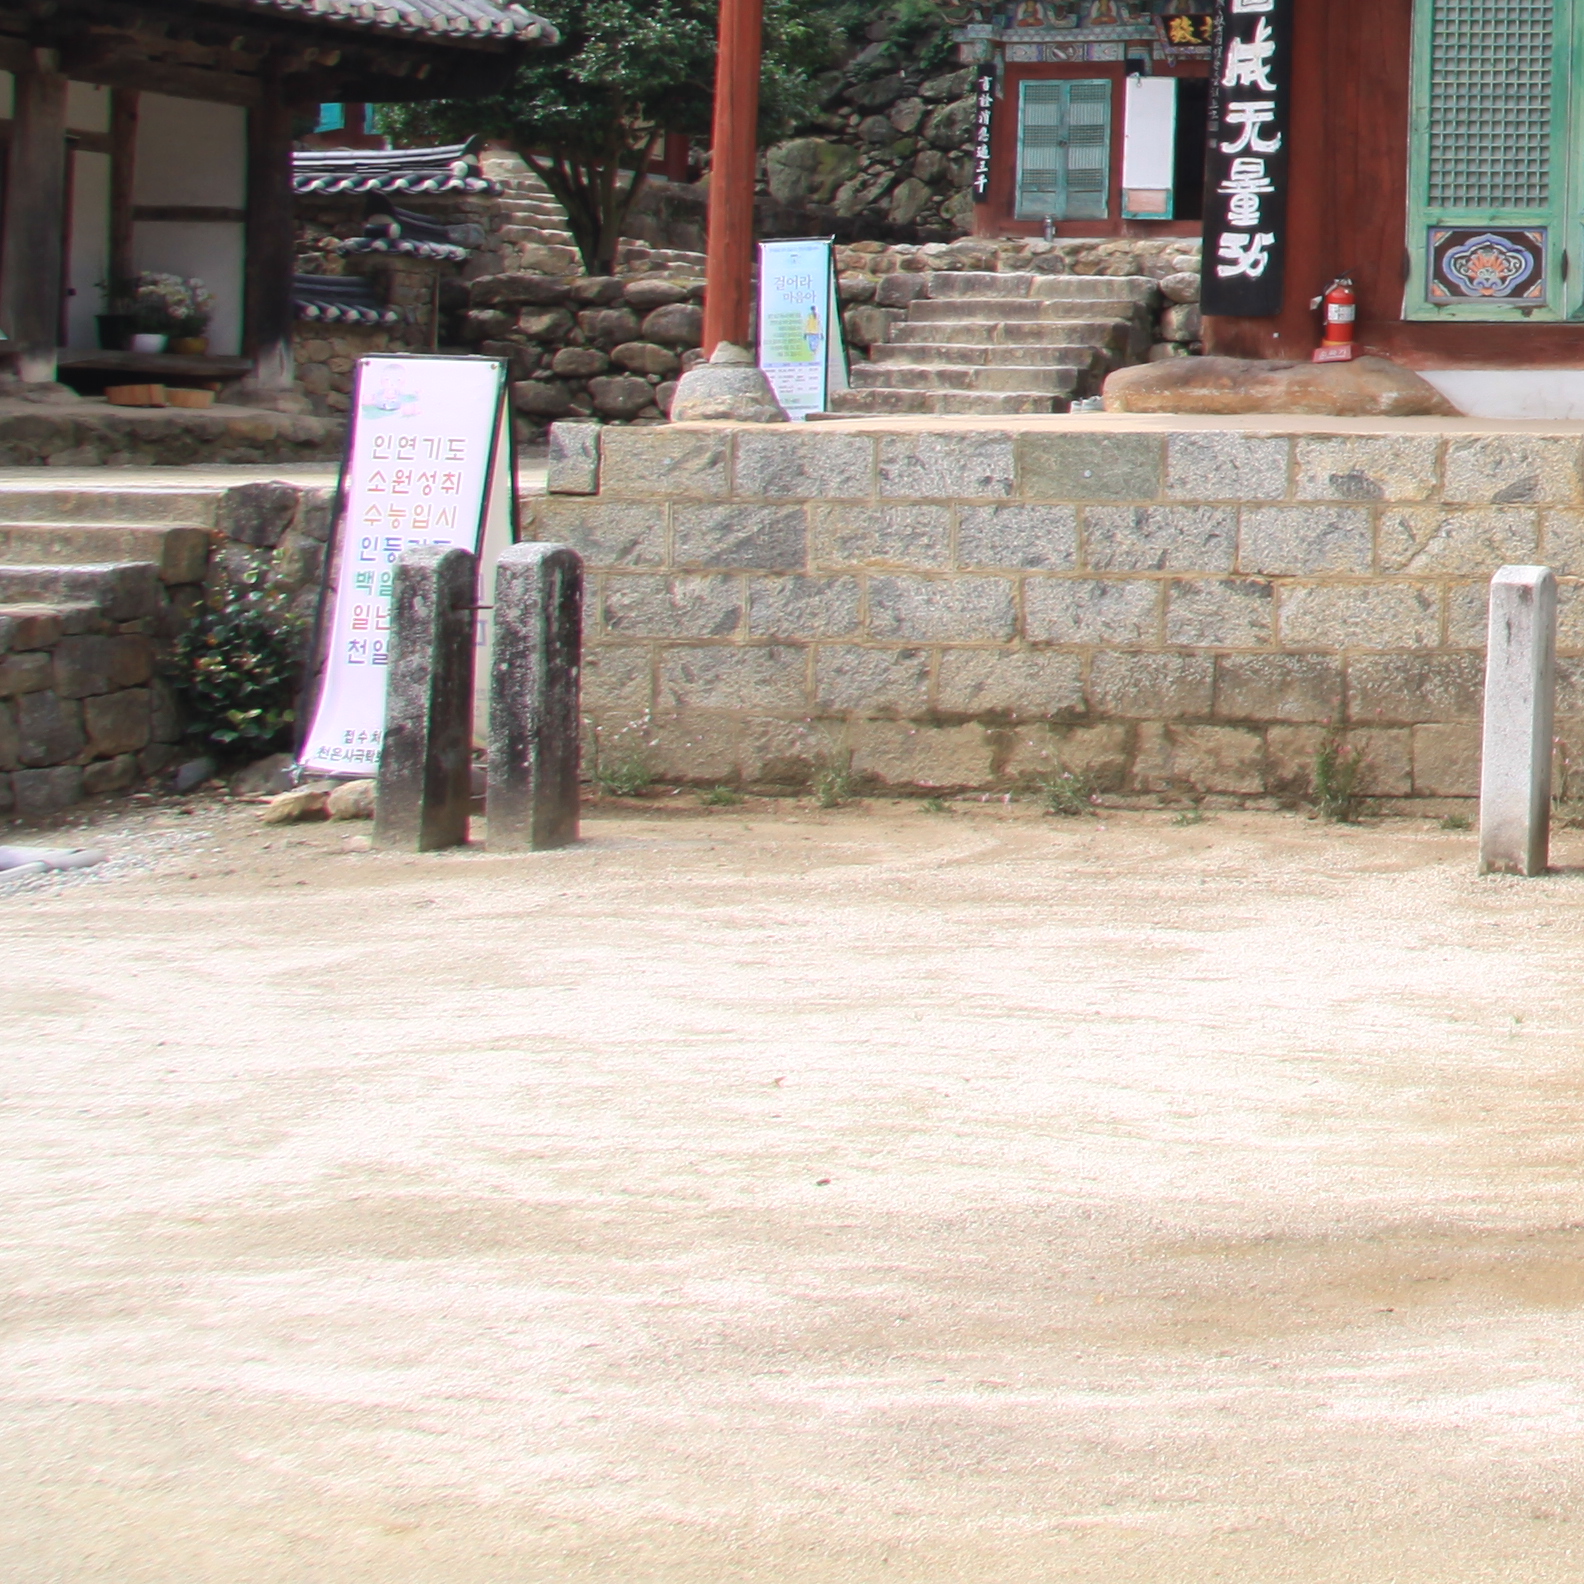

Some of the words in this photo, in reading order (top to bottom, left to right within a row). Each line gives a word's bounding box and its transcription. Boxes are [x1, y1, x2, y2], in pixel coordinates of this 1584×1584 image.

[372, 435, 466, 461] 인연기도
[367, 469, 462, 496] 소원성취
[363, 503, 457, 529] 수능입시
[359, 536, 453, 564] 인등
